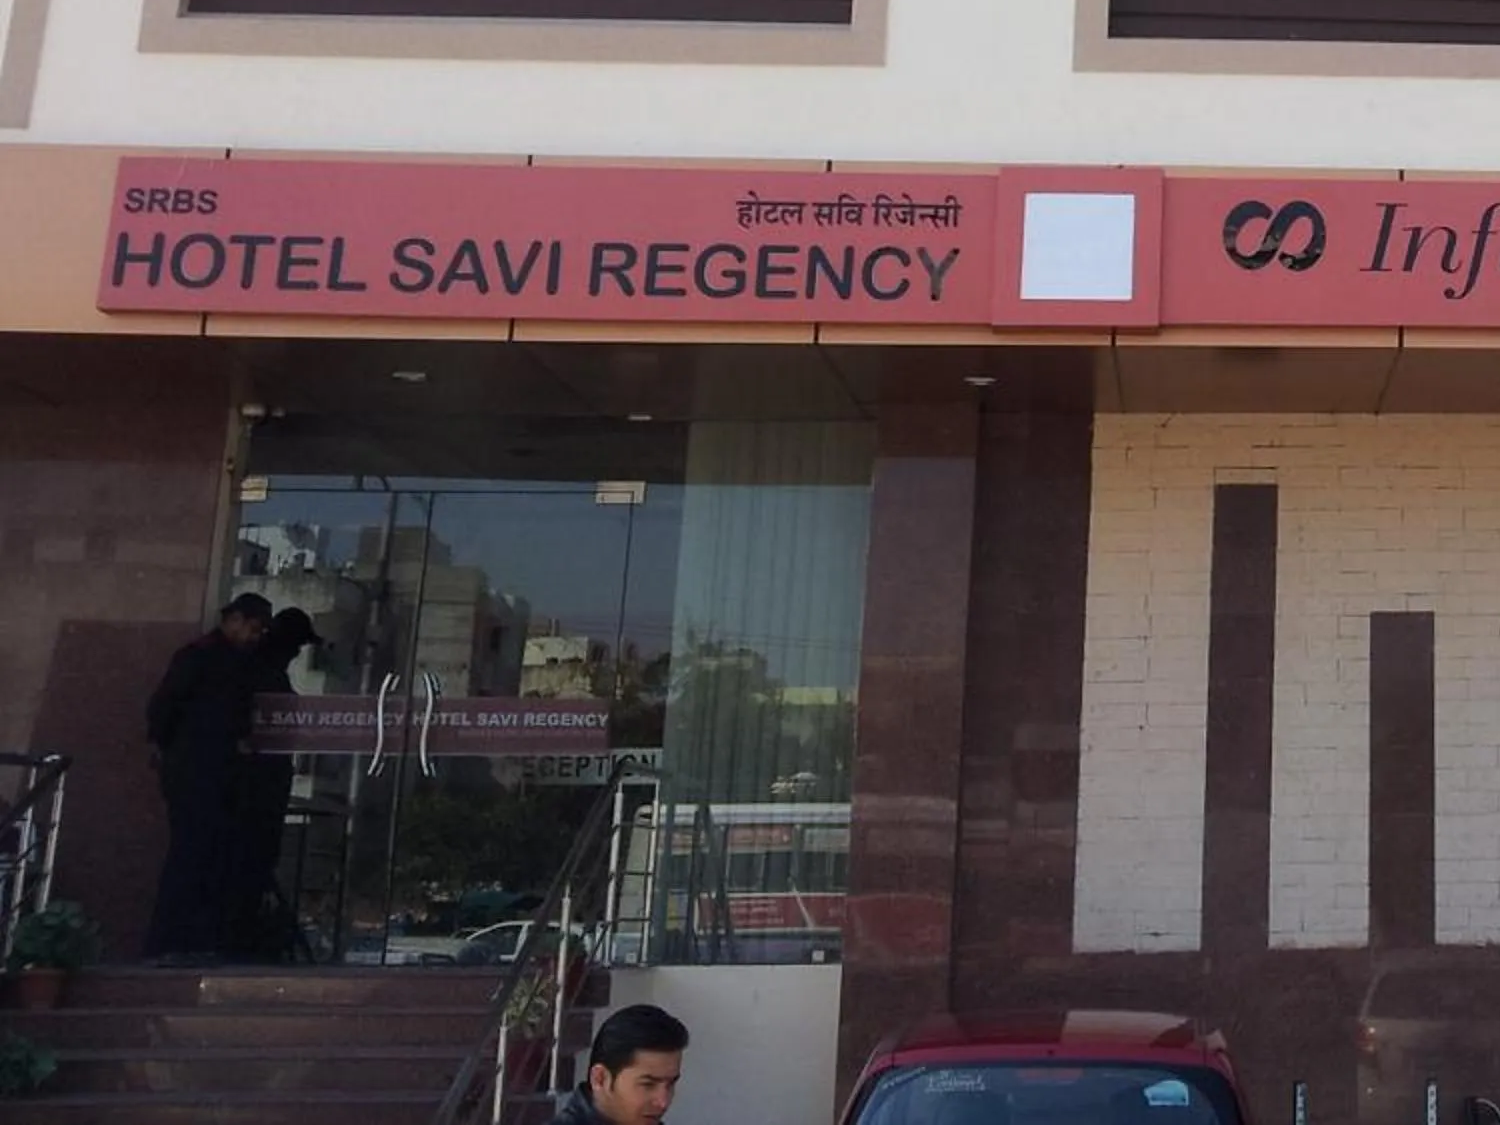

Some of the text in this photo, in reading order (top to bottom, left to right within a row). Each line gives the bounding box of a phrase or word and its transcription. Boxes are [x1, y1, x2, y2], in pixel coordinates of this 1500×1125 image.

[123, 188, 219, 215] SRBS
[736, 191, 806, 229] होटल
[111, 231, 961, 302] HOTEL SAVI REGENCY
[271, 711, 314, 725] SAVI
[476, 712, 518, 727] SAVI
[523, 712, 609, 727] REGENCY
